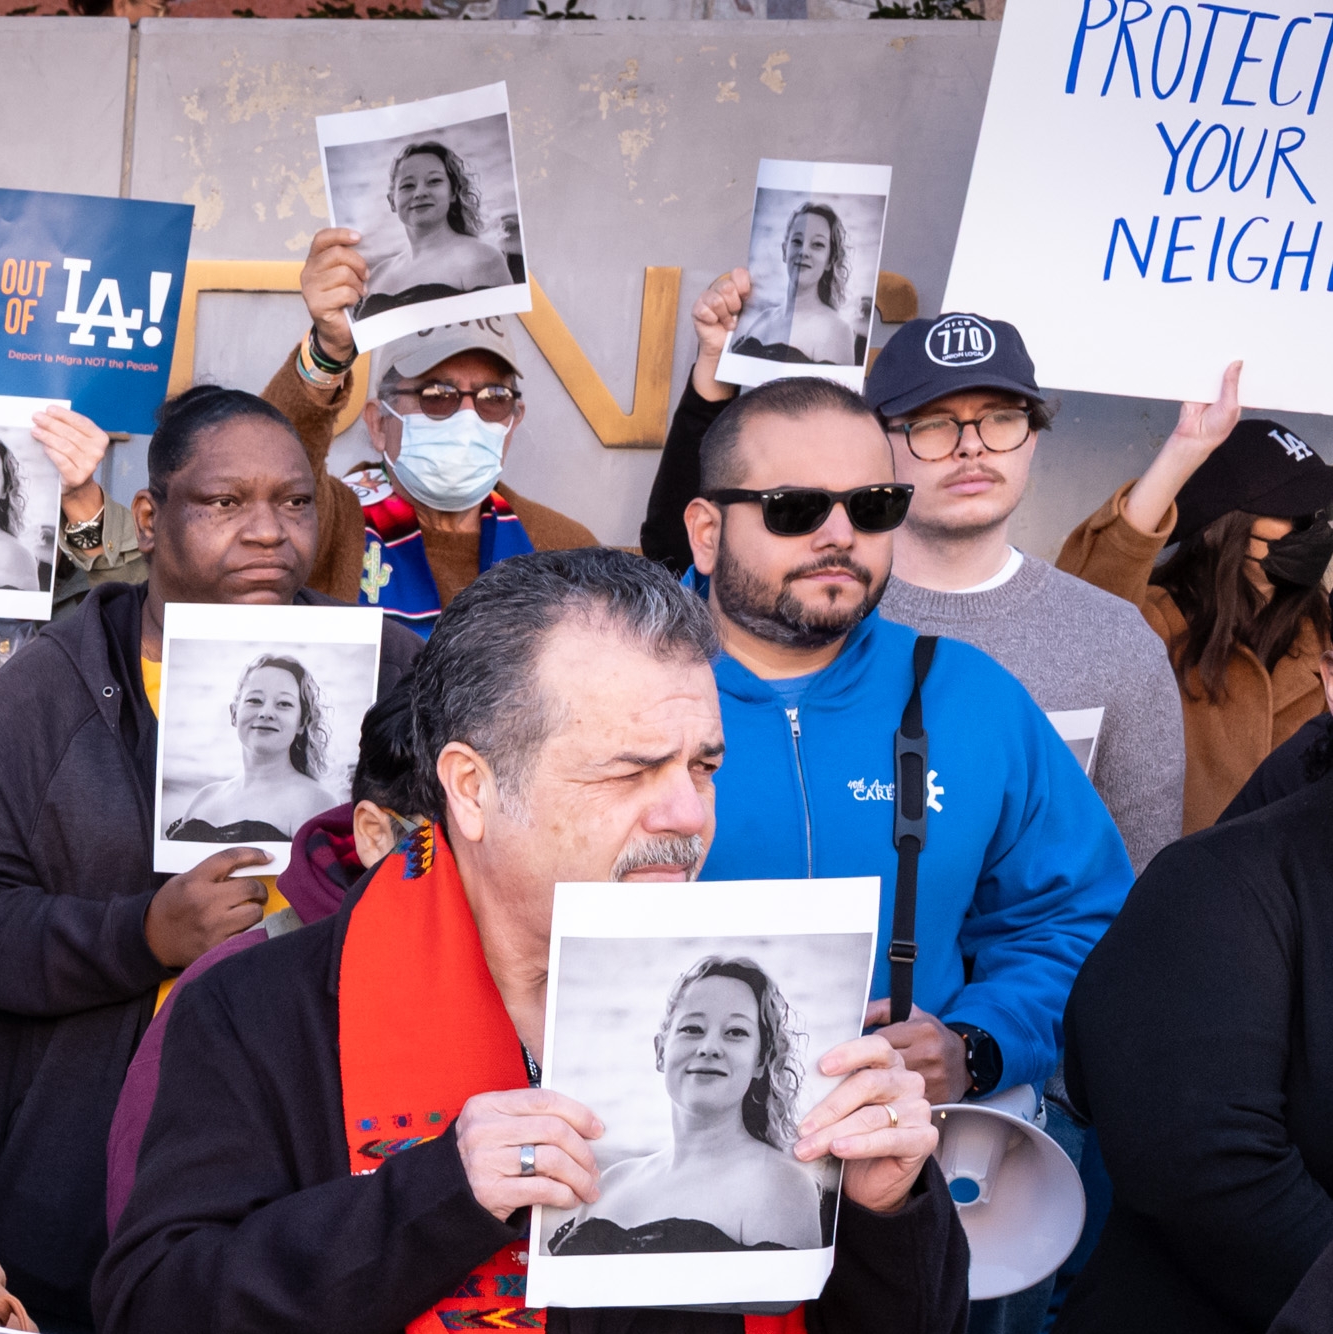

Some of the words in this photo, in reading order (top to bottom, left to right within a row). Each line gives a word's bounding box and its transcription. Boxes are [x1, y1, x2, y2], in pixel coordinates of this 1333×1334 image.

[1065, 0, 1333, 115] PROTECT
[1155, 118, 1317, 205] YOUR
[1103, 215, 1333, 292] NEIGH
[0, 258, 52, 298] OUT
[4, 297, 38, 335] OF
[55, 256, 173, 350] LA!
[937, 326, 984, 355] 770
[944, 319, 971, 329] UFCW
[7, 349, 42, 362] Deport
[44, 353, 53, 363] la
[55, 354, 82, 366] Migra
[84, 357, 107, 367] NOT
[108, 359, 124, 369] the
[126, 360, 159, 373] People
[941, 351, 964, 361] UNION
[964, 350, 985, 358] LOCAL
[1267, 429, 1314, 462] LA
[853, 788, 895, 801] CARE
